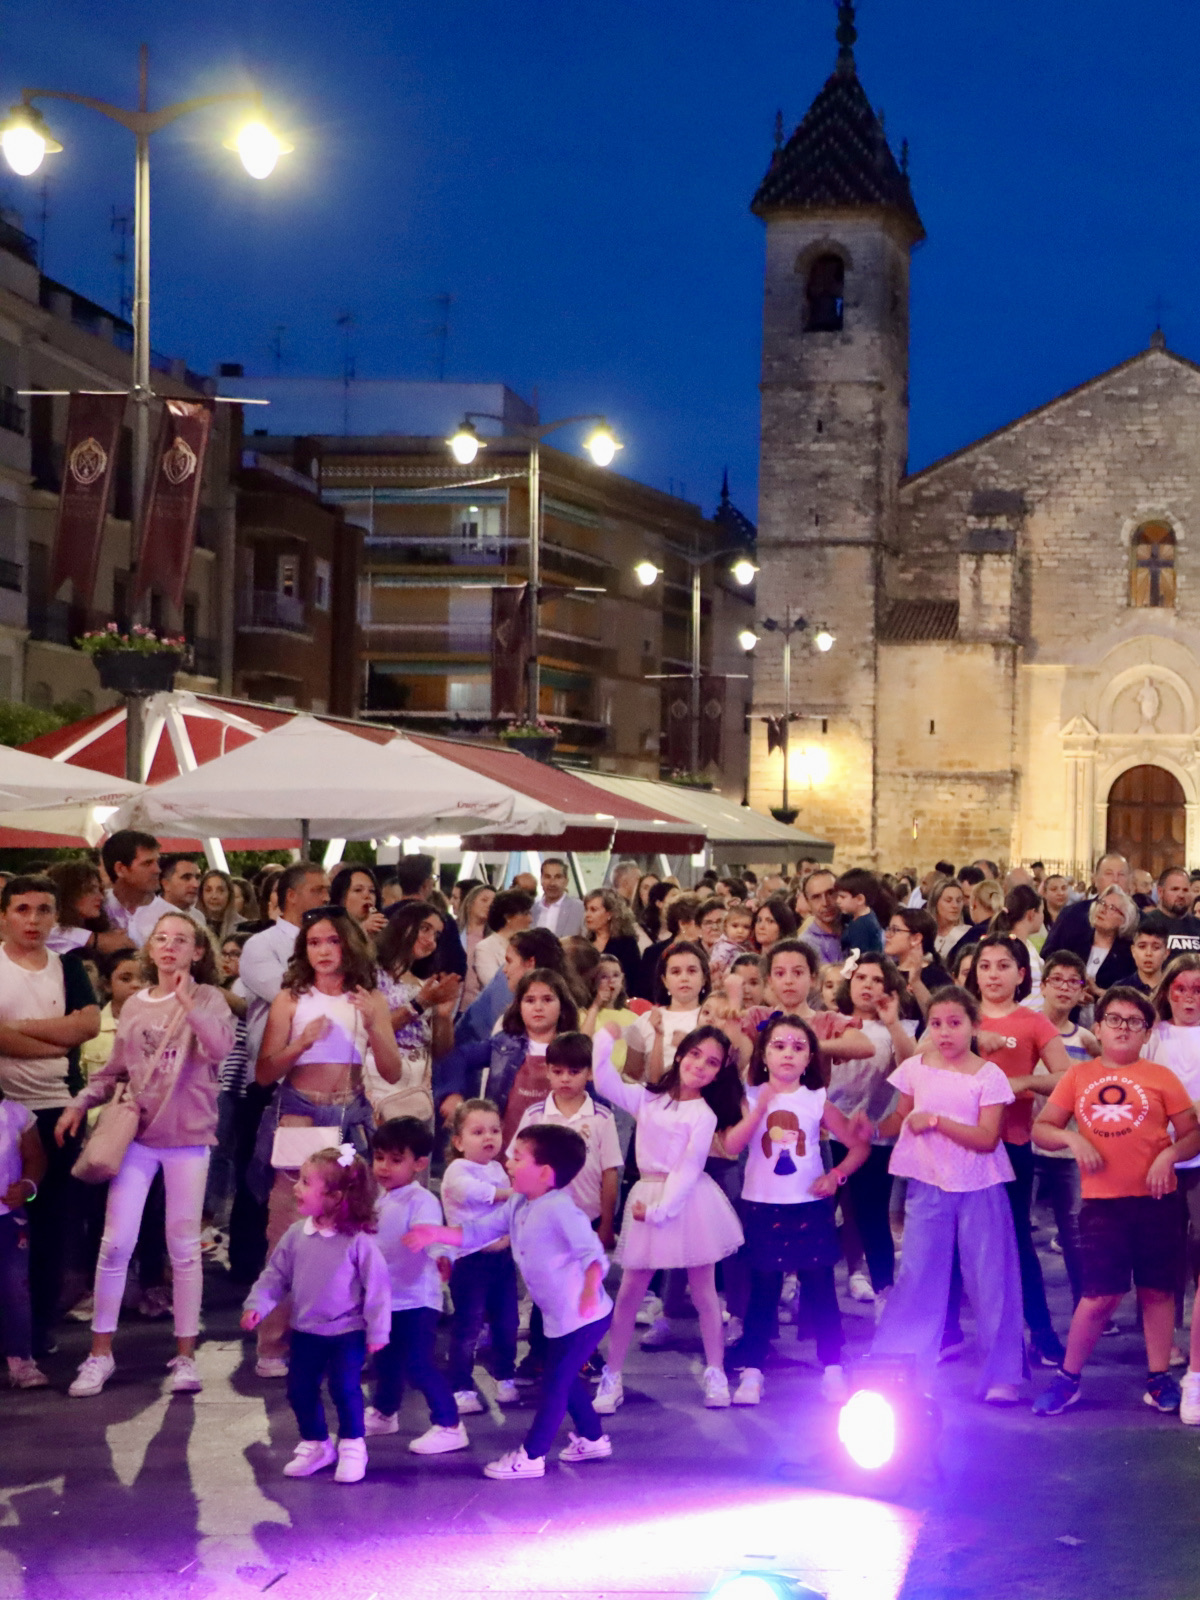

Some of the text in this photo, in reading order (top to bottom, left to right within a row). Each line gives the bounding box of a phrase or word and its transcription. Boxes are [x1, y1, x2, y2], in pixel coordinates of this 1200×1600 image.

[1084, 1075, 1118, 1095] COLORS
[1121, 1077, 1134, 1085] OF
[1133, 1083, 1149, 1127] BENETTON
